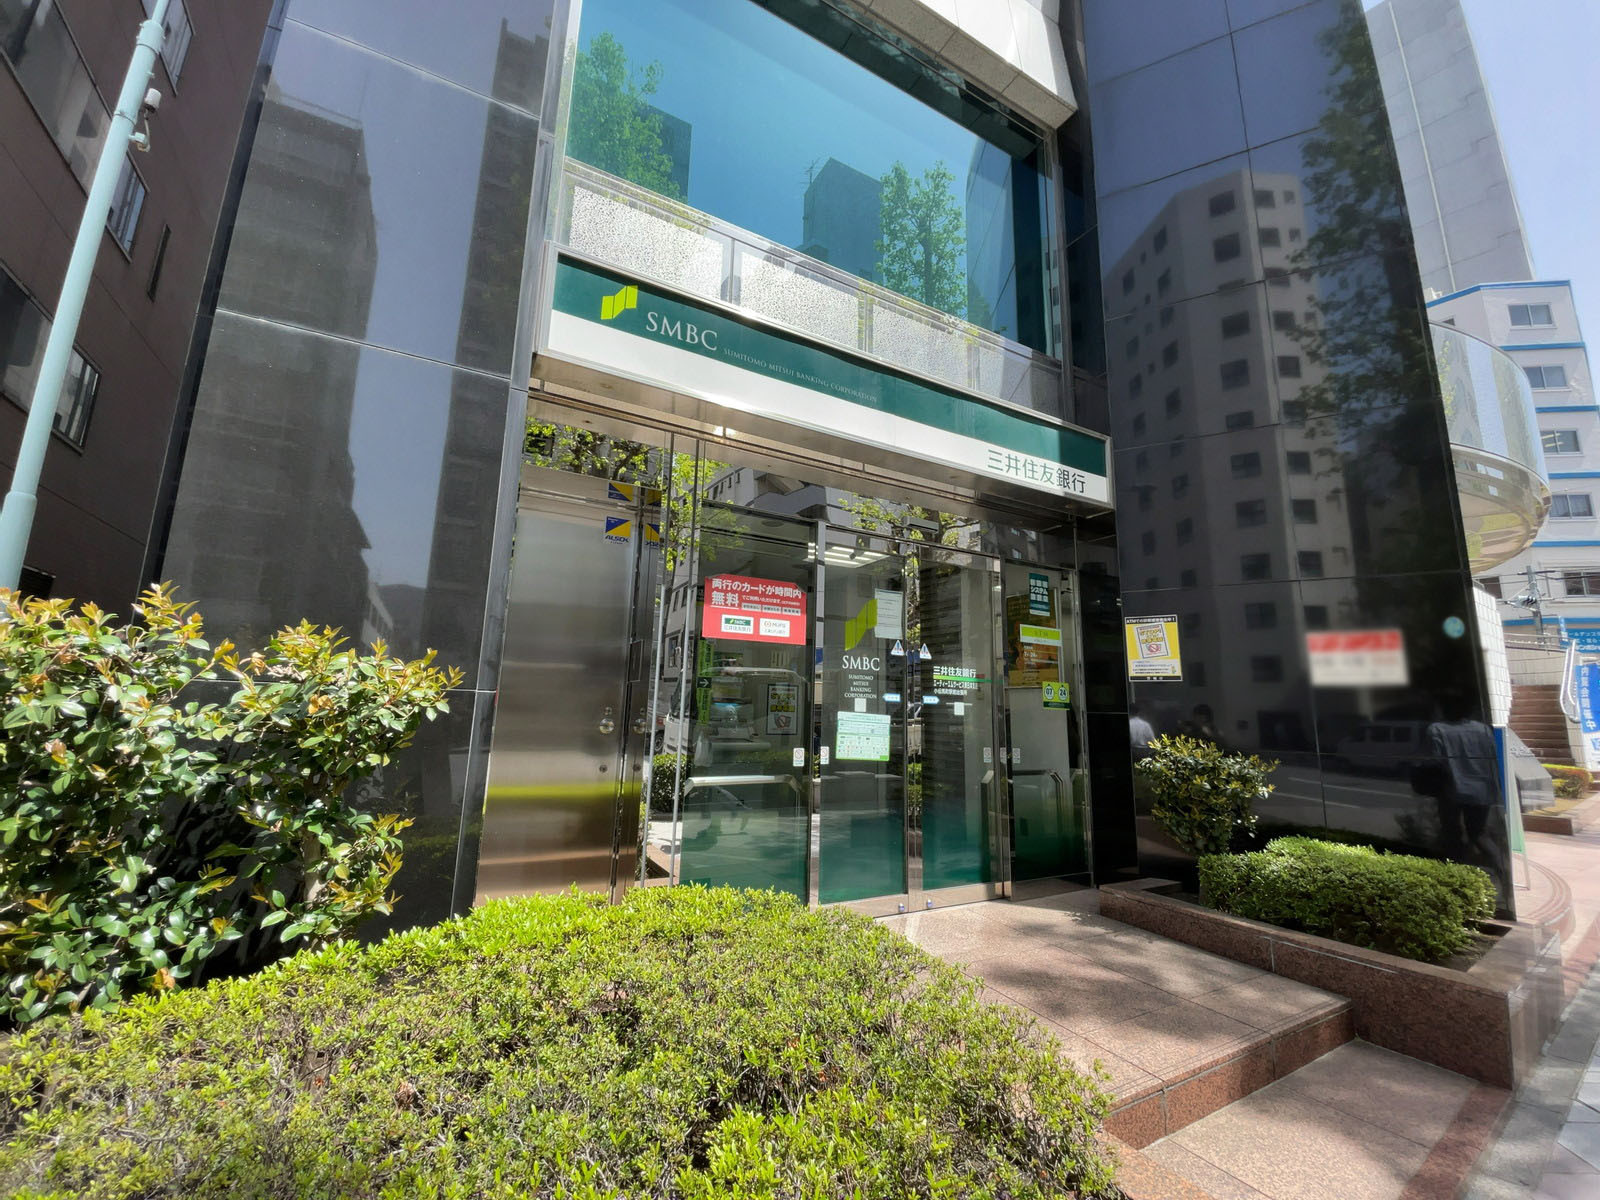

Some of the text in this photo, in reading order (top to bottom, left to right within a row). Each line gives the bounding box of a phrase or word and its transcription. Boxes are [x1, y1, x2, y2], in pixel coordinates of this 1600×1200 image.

[645, 311, 718, 351] SMBC
[723, 348, 877, 403] SUMITOMO MITSUI BANKING CORPORATION
[987, 449, 1086, 494] 三井住友銀行
[605, 534, 629, 543] ALSOK
[711, 578, 802, 599] 両行のカードが時間内
[711, 590, 739, 607] 無料
[842, 655, 880, 671] SMBC
[933, 665, 977, 679] 三井住友銀行
